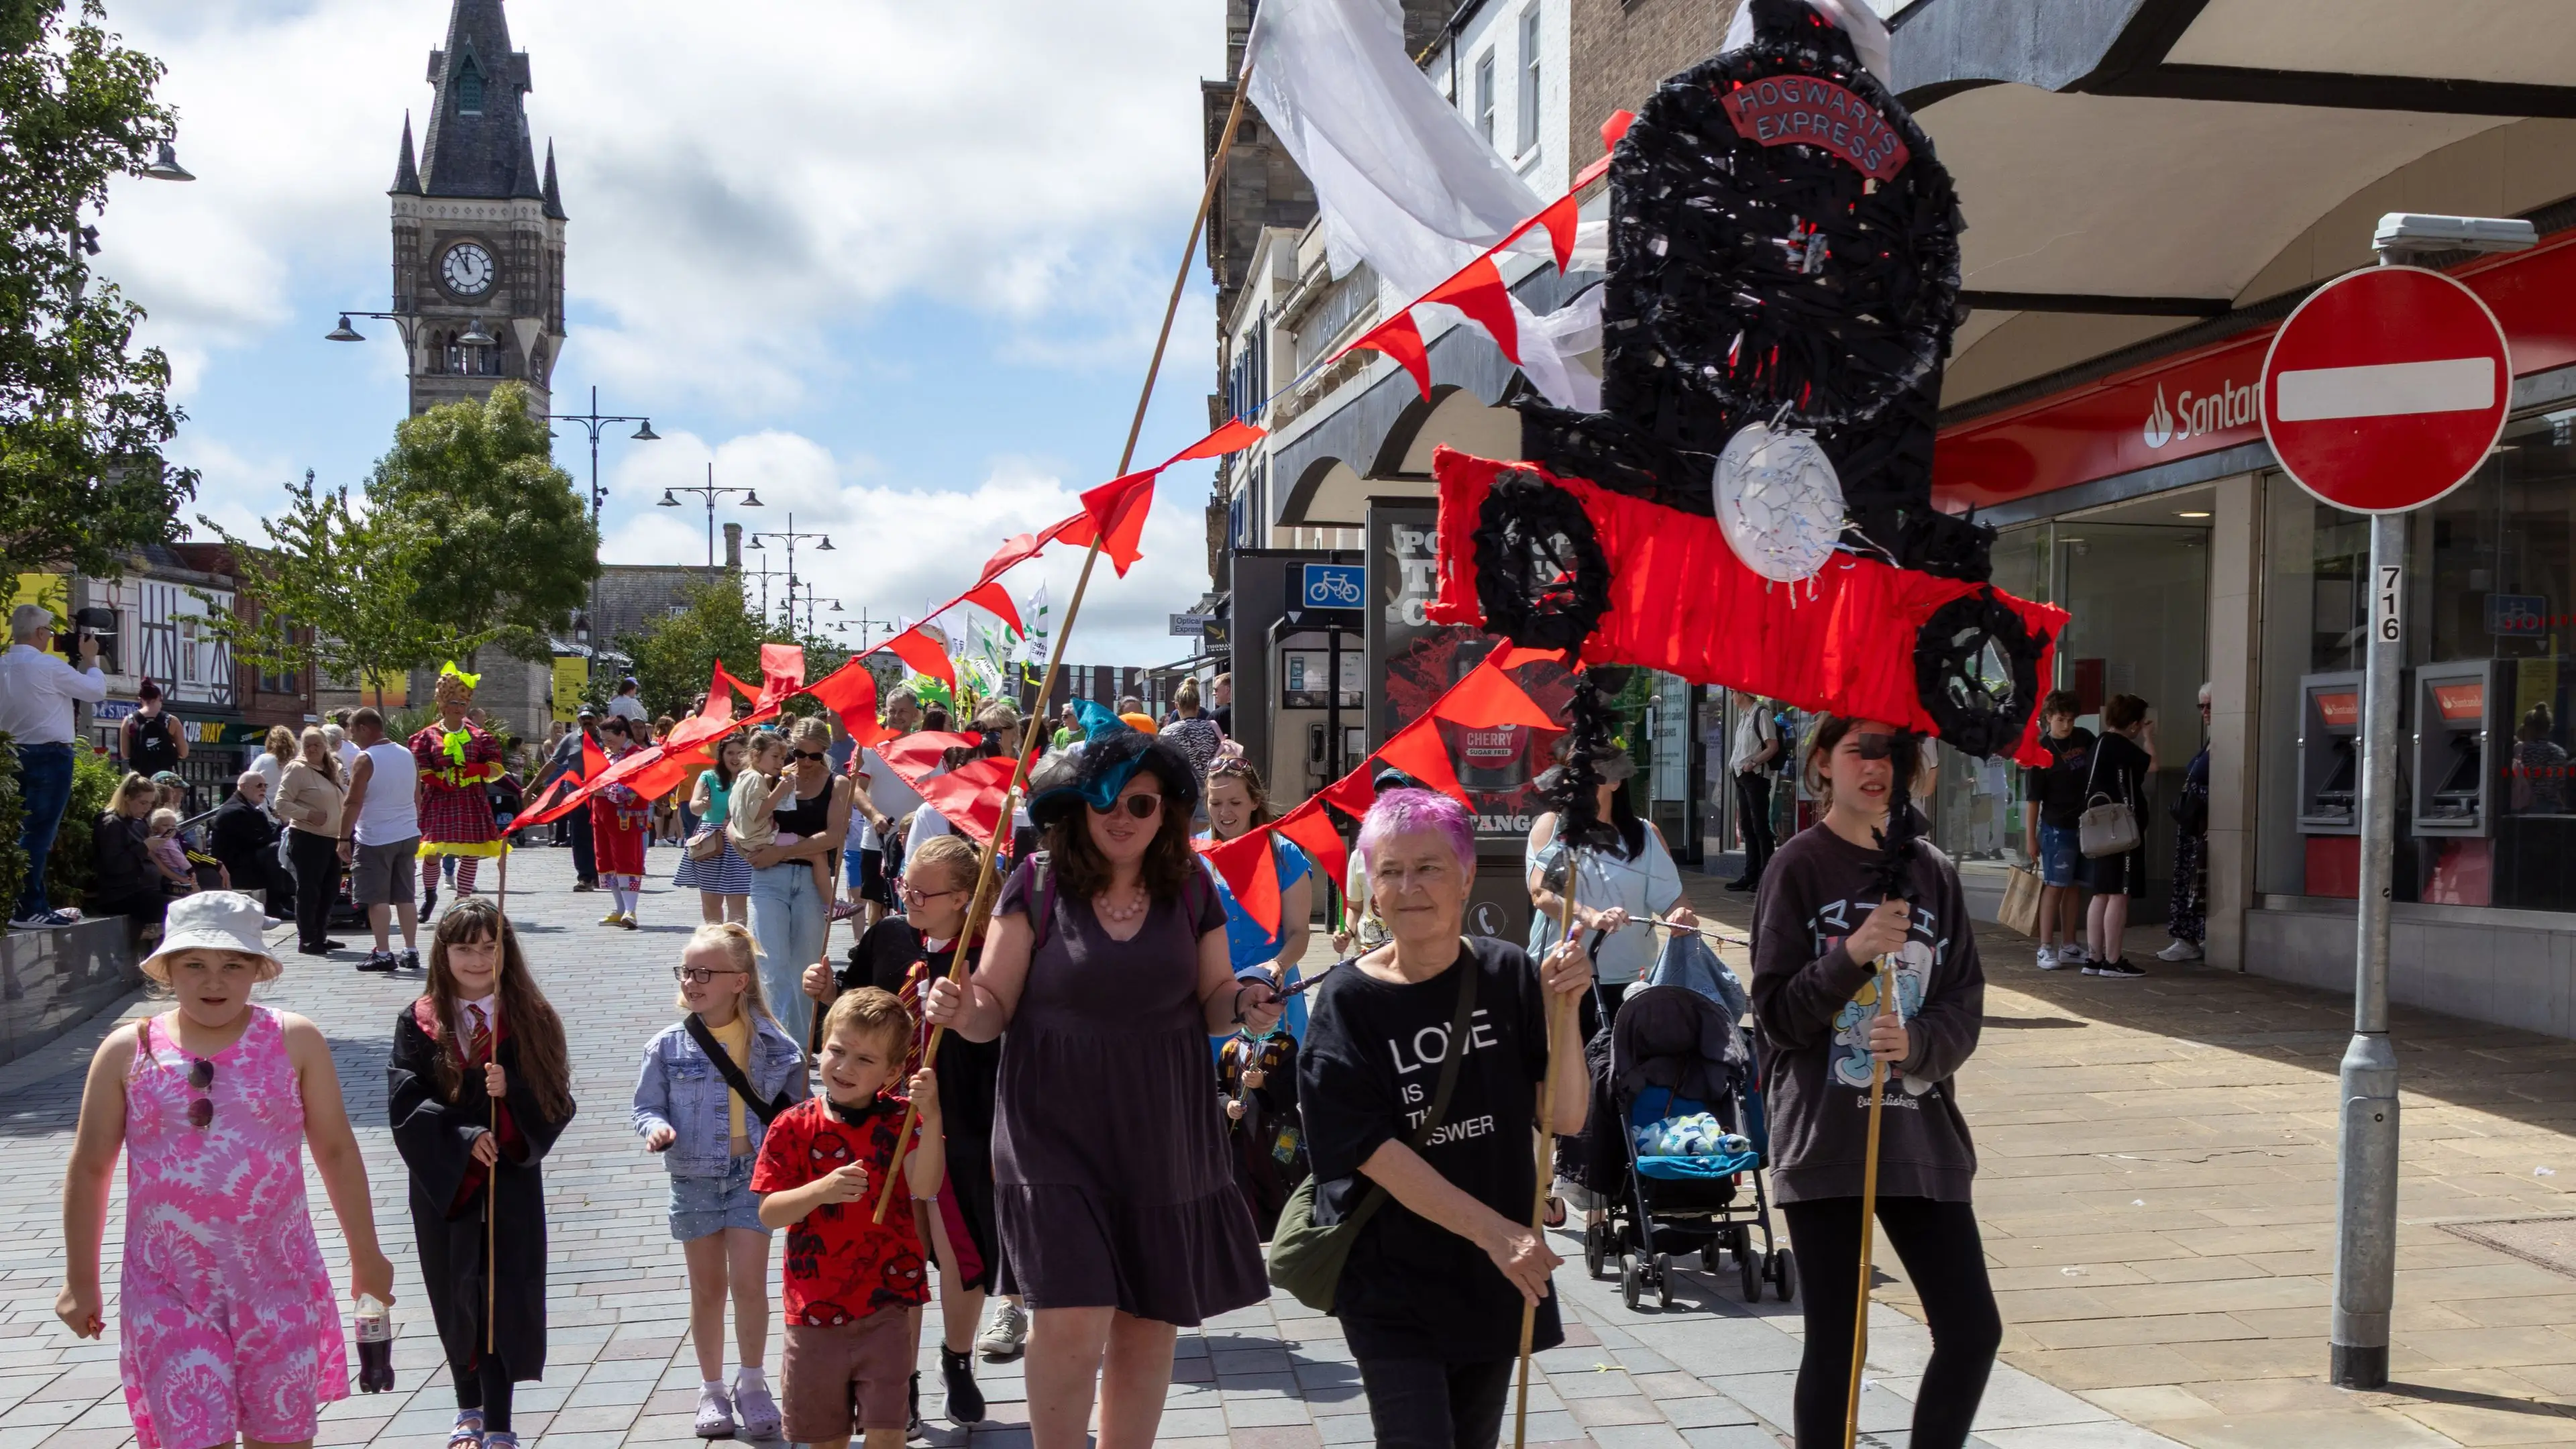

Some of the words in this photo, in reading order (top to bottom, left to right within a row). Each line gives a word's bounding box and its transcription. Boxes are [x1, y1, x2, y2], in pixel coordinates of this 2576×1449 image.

[1737, 80, 1898, 155] HOGWARTS
[1757, 111, 1882, 170] EXPRESS
[2381, 567, 2400, 641] 716
[1175, 625, 1203, 633] Express
[99, 704, 107, 717] &
[109, 704, 115, 718] S
[183, 720, 225, 743] SUBWAY
[1467, 733, 1513, 746] CHERRY
[1401, 1083, 1424, 1104] IS
[1405, 1106, 1432, 1130] TH
[1426, 1115, 1495, 1146] SWER
